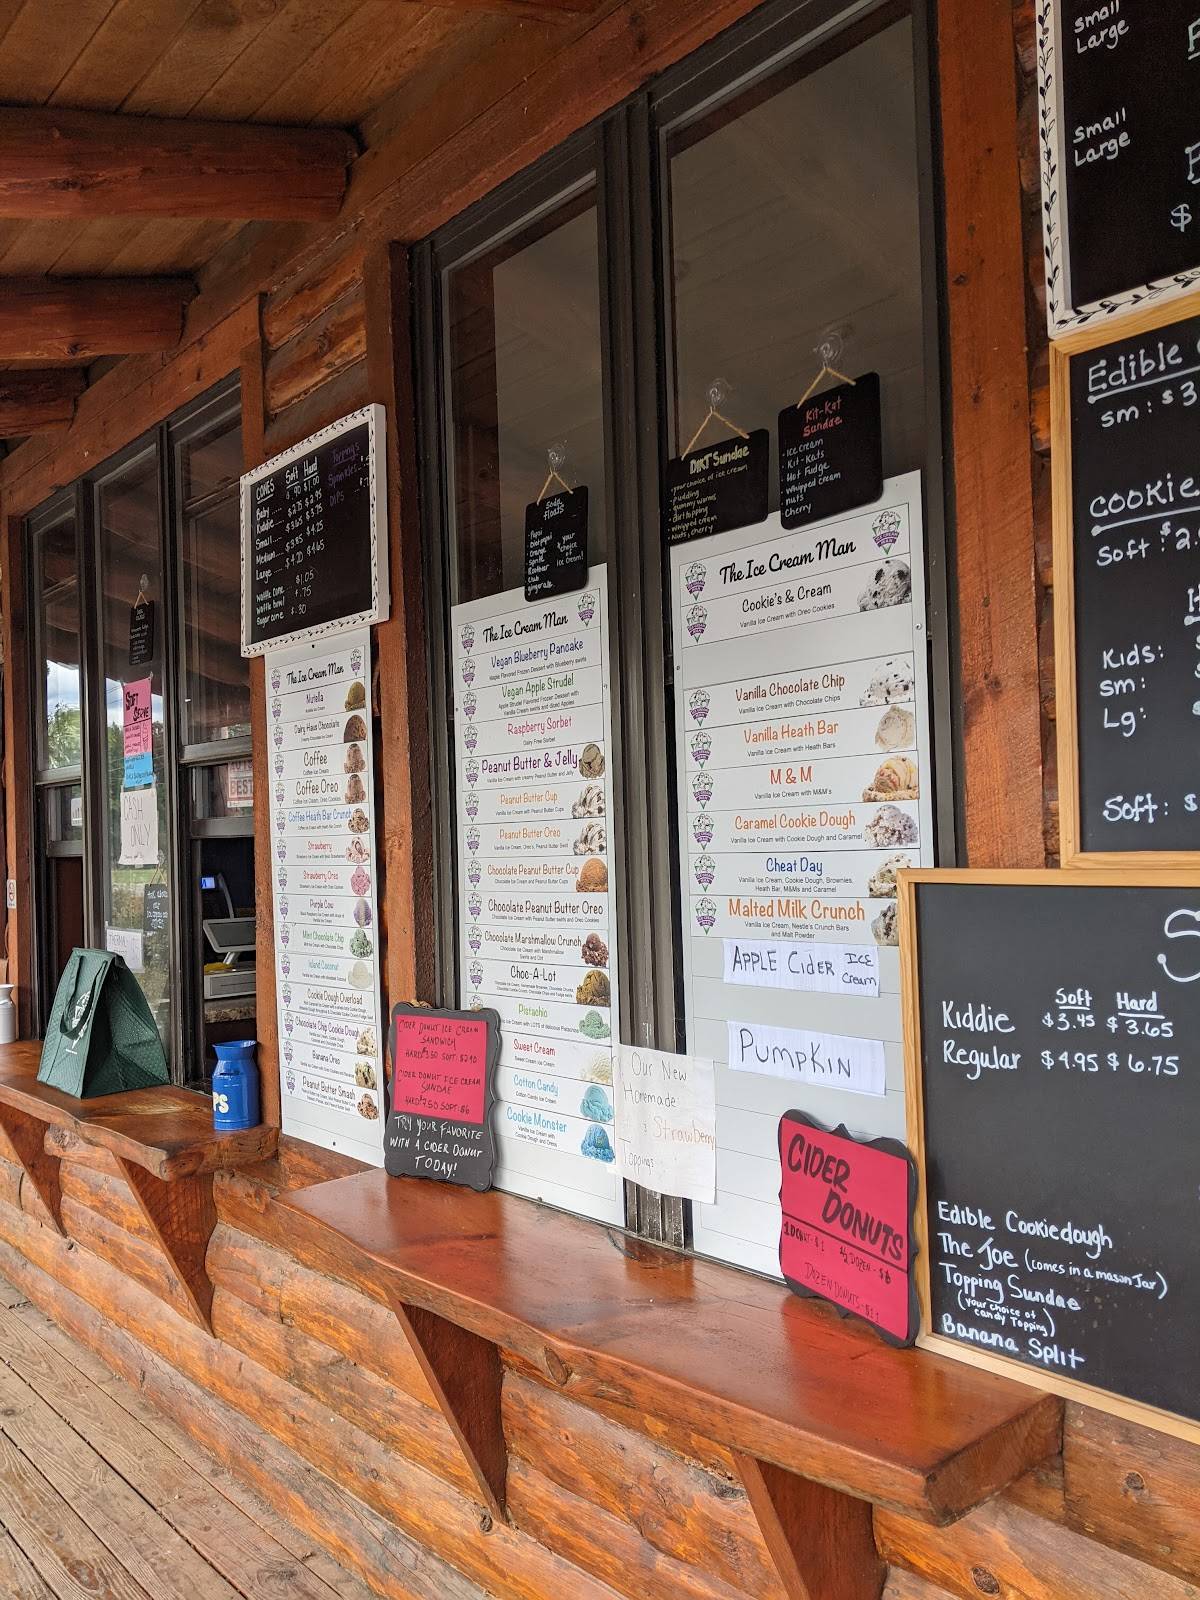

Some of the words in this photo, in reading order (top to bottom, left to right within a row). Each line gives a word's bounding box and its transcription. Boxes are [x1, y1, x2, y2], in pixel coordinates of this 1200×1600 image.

[1074, 0, 1119, 34] Small
[1077, 20, 1129, 54] Large
[1073, 107, 1126, 144] Small
[1075, 131, 1131, 167] Large
[1089, 342, 1182, 392] Edible
[805, 396, 842, 422] Kit-Kat
[803, 416, 842, 438] Sundae
[713, 445, 749, 467] Sundae
[787, 451, 825, 469] Kit-Kats
[256, 478, 275, 500] CONES
[286, 465, 299, 484] Soft
[304, 456, 318, 477] Hard
[786, 469, 801, 482] Hot
[804, 462, 830, 477] Fudge
[818, 472, 841, 487] cream
[256, 535, 272, 550] Small
[720, 562, 744, 585] The
[745, 560, 767, 580] Ice
[769, 551, 814, 576] Cream
[816, 538, 856, 563] Man
[256, 570, 272, 583] Large
[742, 589, 783, 614] Cookie's
[785, 590, 794, 602] &
[797, 582, 832, 602] Cream
[483, 627, 499, 643] The
[500, 626, 512, 639] Ice
[514, 620, 542, 635] Cream
[543, 612, 568, 628] Man
[740, 619, 756, 628] Vanilla
[757, 616, 765, 625] Ice
[767, 612, 784, 623] Cream
[785, 611, 796, 619] with
[798, 608, 810, 617] Oreo
[812, 603, 835, 615] Cookies
[491, 656, 512, 669] Vegan
[514, 646, 548, 664] Blueberry
[550, 638, 583, 656] Pancake
[1102, 644, 1164, 669] Kids:
[502, 685, 523, 699] Vegan
[526, 681, 545, 697] Apple
[547, 673, 574, 689] Strudel
[735, 686, 767, 702] Vanilla
[769, 678, 819, 697] Chocolate
[822, 674, 845, 691] Chip
[508, 718, 545, 737] Raspberry
[547, 715, 572, 729] Sorbet
[744, 727, 778, 744] Vanilla
[782, 723, 815, 740] Heath
[818, 719, 838, 735] Bar
[304, 751, 328, 767] Coffee
[482, 759, 511, 774] Peanut
[513, 756, 541, 770] Butter
[544, 752, 552, 768] &
[555, 750, 578, 769] Jelly
[296, 780, 320, 796] Coffee
[321, 778, 338, 793] Oreo
[770, 769, 781, 785] M
[786, 770, 796, 784] &
[801, 766, 812, 782] M
[735, 814, 776, 831] Caramel
[780, 813, 817, 828] Cookie
[819, 810, 856, 831] Dough
[308, 841, 332, 852] Strawberry
[766, 857, 798, 873] Cheat
[800, 857, 823, 876] Day
[488, 899, 523, 913] Chocolate
[525, 901, 552, 914] Peanut
[555, 901, 580, 914] Butter
[582, 901, 603, 915] Oreo
[728, 899, 774, 918] Malted
[778, 900, 807, 920] Milk
[811, 901, 865, 921] Crunch
[485, 930, 514, 943] Chocolate
[515, 933, 556, 946] Marshmallow
[558, 934, 581, 947] Crunch
[732, 946, 776, 972] APPLE
[511, 965, 556, 982] Choc-A-Lot
[518, 1003, 548, 1018] Pistachio
[1055, 987, 1092, 1007] Soft
[1116, 991, 1158, 1012] Hard
[942, 1000, 1016, 1033] Kiddie
[1106, 1016, 1174, 1038] $3.65
[513, 1039, 533, 1052] Sweet
[534, 1042, 555, 1056] Cream
[943, 1040, 1021, 1080] Regular
[1107, 1052, 1179, 1076] $6.75
[632, 1052, 652, 1076] Our
[662, 1059, 687, 1081] New
[302, 1076, 320, 1090] Peanut
[321, 1081, 337, 1095] Butter
[338, 1086, 356, 1100] Smash
[513, 1074, 536, 1089] Cotton
[537, 1079, 559, 1097] Candy
[394, 1115, 412, 1132] TRY
[416, 1117, 438, 1137] YOUR
[440, 1122, 483, 1140] FAVORITE
[506, 1106, 533, 1122] Cookie
[533, 1114, 567, 1133] Monster
[654, 1116, 714, 1150] Strawberry
[390, 1137, 410, 1148] WITH
[424, 1140, 449, 1154] CIDER
[453, 1144, 483, 1158] DONUT
[415, 1155, 457, 1178] TODAY!
[788, 1133, 851, 1193] CIDER
[822, 1190, 904, 1260] DONUTS
[938, 1201, 995, 1230] Edible
[938, 1233, 973, 1258] The
[977, 1237, 1018, 1270] Joe
[1069, 1262, 1081, 1276] in
[1084, 1268, 1093, 1278] a
[1096, 1270, 1132, 1287] mason
[939, 1262, 1004, 1303] Topping
[1008, 1275, 1081, 1311] Sundae
[942, 1313, 1019, 1352] Banana
[1029, 1339, 1085, 1369] Split
